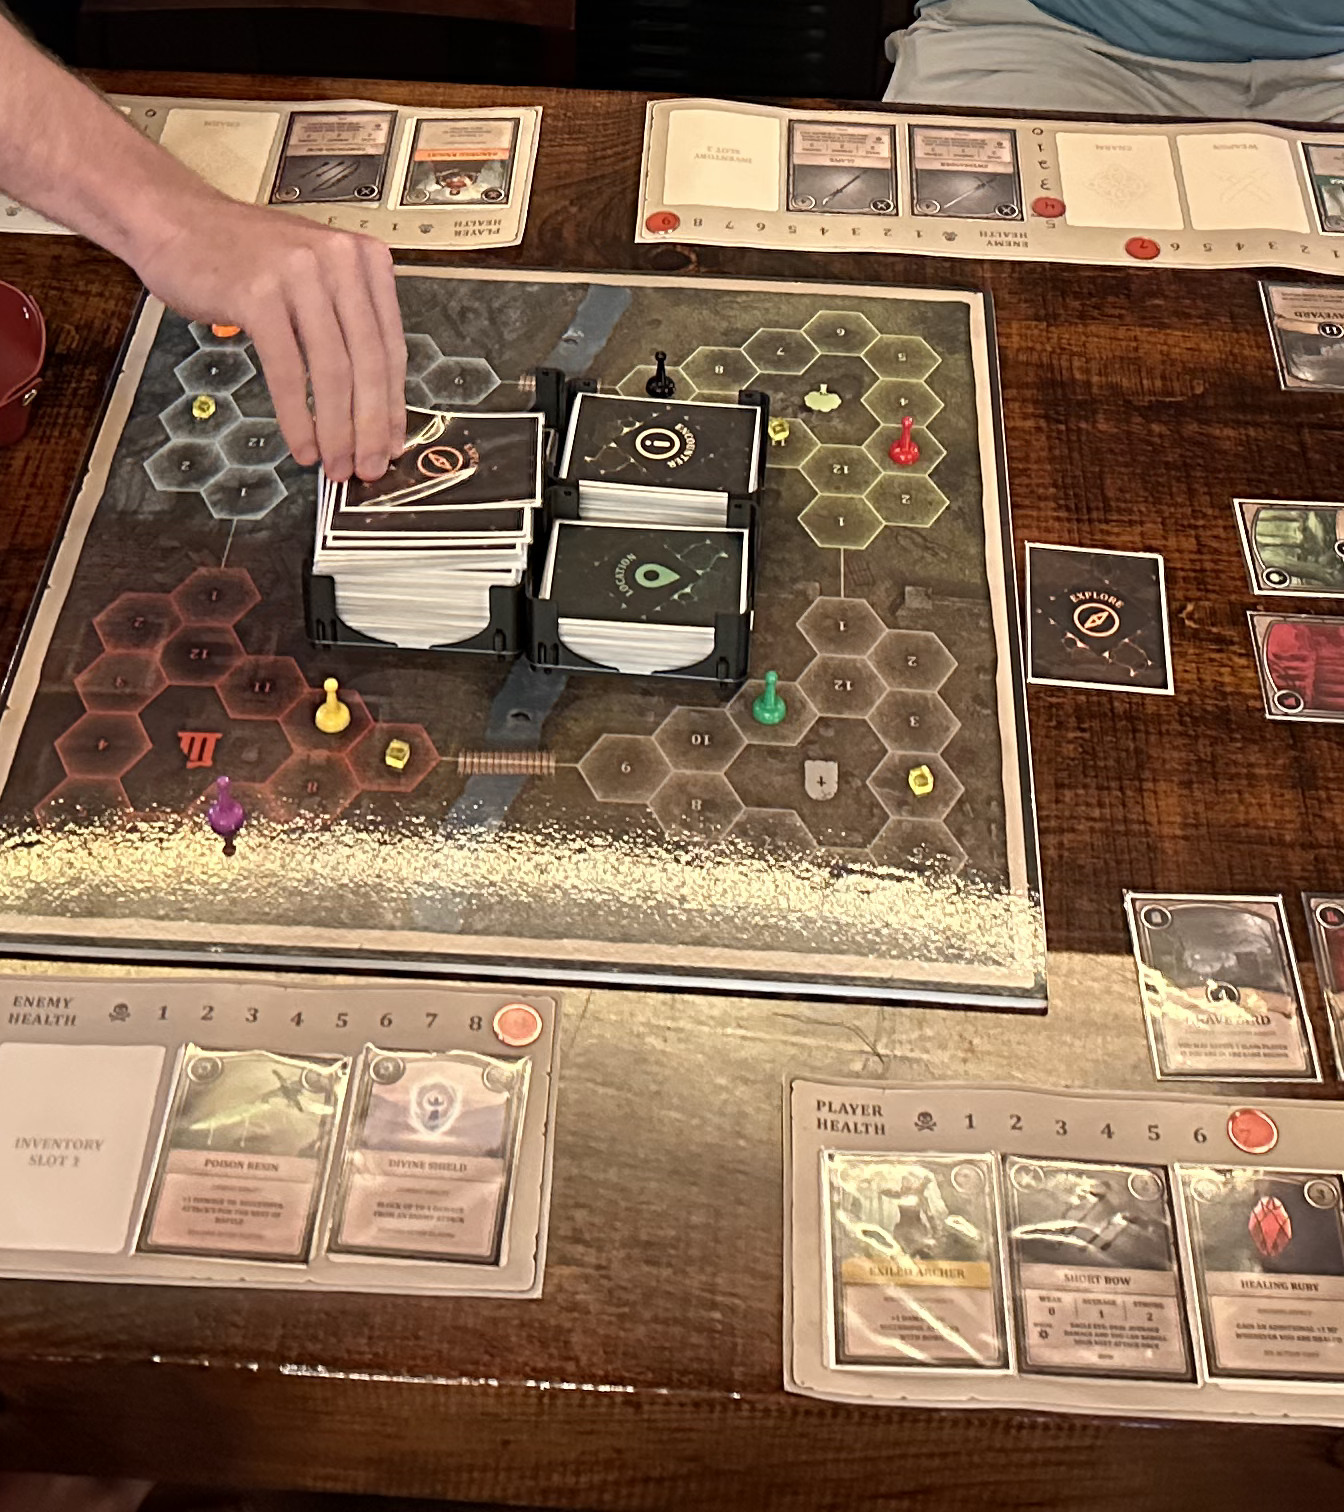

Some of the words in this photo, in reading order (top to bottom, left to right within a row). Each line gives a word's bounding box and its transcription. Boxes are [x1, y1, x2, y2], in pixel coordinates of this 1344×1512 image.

[453, 219, 502, 228] HEALTH
[454, 229, 500, 237] PLAYER
[979, 230, 1028, 239] HEALTH
[986, 240, 1029, 248] ENEMY
[667, 423, 697, 469] ENCOUNTER
[614, 553, 637, 598] LOCATION
[1069, 590, 1125, 609] EXPLORE
[907, 656, 917, 667] 2
[834, 680, 852, 691] 12
[910, 715, 920, 727] 3
[13, 995, 74, 1010] ENEMY
[8, 1011, 77, 1027] HEALTH
[158, 1005, 169, 1020] 1
[201, 1005, 215, 1021] 2
[245, 1007, 259, 1024] 3
[290, 1011, 304, 1028] 4
[335, 1011, 349, 1030] 5
[380, 1012, 393, 1029] 6
[426, 1012, 438, 1028] 7
[469, 1014, 483, 1032] 8
[816, 1099, 884, 1118] PLAYER
[816, 1118, 886, 1136] HEALTH
[964, 1114, 976, 1130] 1
[1010, 1114, 1023, 1131] 2
[1056, 1119, 1068, 1137] 3
[1101, 1123, 1115, 1140] 4
[1148, 1124, 1161, 1141] 5
[1194, 1127, 1207, 1144] 6
[14, 1137, 104, 1152] INVENTORY
[28, 1154, 66, 1167] SLOT
[204, 1158, 244, 1170] POISON
[247, 1159, 279, 1172] RESIN
[388, 1158, 426, 1170] DIVINE
[428, 1160, 468, 1173] SHIELD
[869, 1266, 912, 1278] EXILED
[917, 1267, 966, 1279] ARCHER
[1064, 1273, 1102, 1285] SHORT
[1104, 1275, 1131, 1286] BOW
[1241, 1279, 1289, 1290] HEALING
[1290, 1281, 1319, 1292] RUBY
